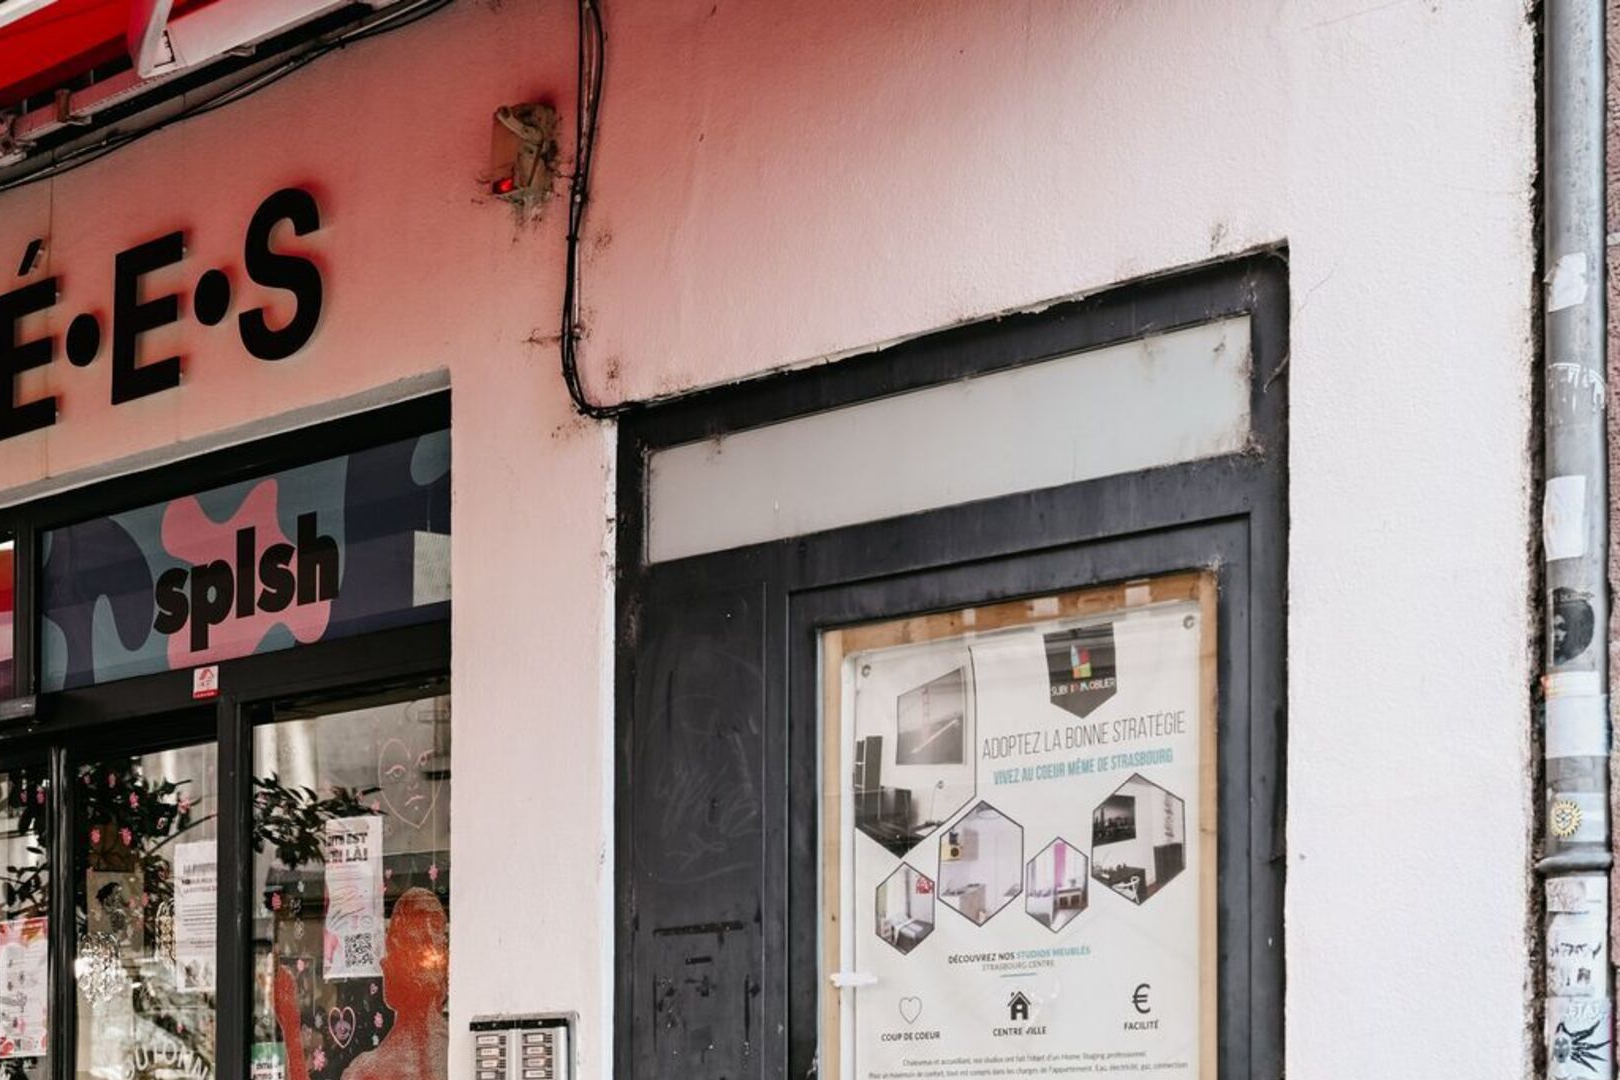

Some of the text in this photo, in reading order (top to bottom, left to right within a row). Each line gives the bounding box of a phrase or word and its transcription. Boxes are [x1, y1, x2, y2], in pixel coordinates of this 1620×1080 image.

[152, 511, 340, 653] splsh
[982, 711, 1186, 760] ADOPTEZ LA BONNE STRATÉGIE
[993, 748, 1173, 785] VIVEZ AU COEUR MÊME DE STRASBOURG
[948, 952, 996, 964] DÉCOUVREZ
[998, 952, 1015, 961] NOS
[1016, 948, 1051, 959] STUDIOS
[982, 960, 1055, 971] STRASBOURG CENTRE
[992, 1027, 1023, 1037] CENTRE
[1123, 1020, 1159, 1031] FACILITÉ
[881, 1031, 941, 1042] COUP DE COEUR
